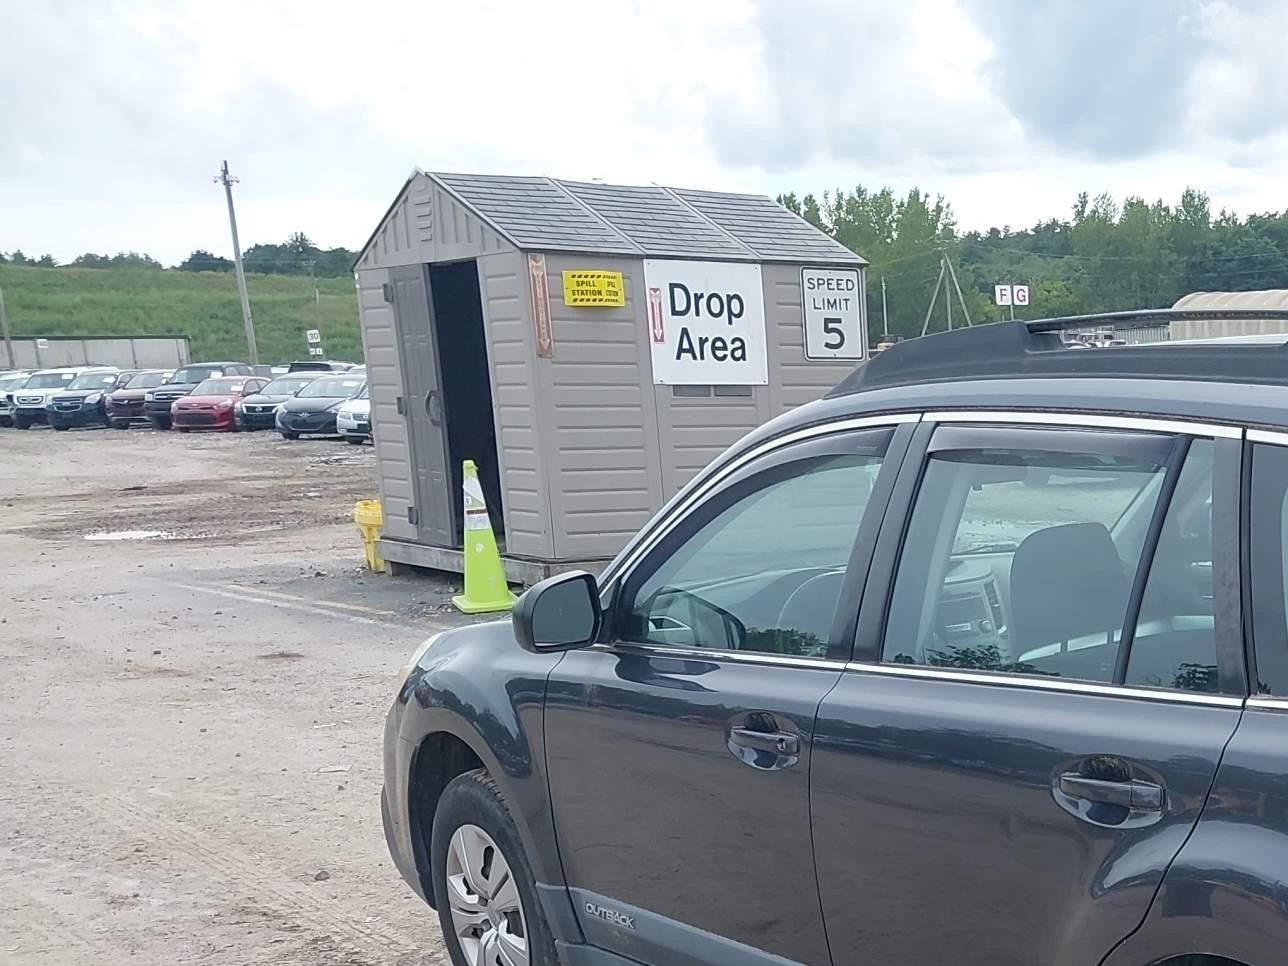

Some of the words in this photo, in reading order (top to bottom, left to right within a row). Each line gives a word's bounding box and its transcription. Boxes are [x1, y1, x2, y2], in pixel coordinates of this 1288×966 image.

[575, 280, 598, 288] SPILL
[806, 277, 855, 291] SPEED
[571, 289, 603, 297] STATION
[1000, 288, 1007, 302] F
[1017, 288, 1026, 302] G
[668, 282, 745, 325] Drop
[813, 297, 850, 312] LIMIT
[823, 317, 846, 350] 5
[675, 327, 748, 362] Area
[585, 902, 635, 929] OUTBACK
